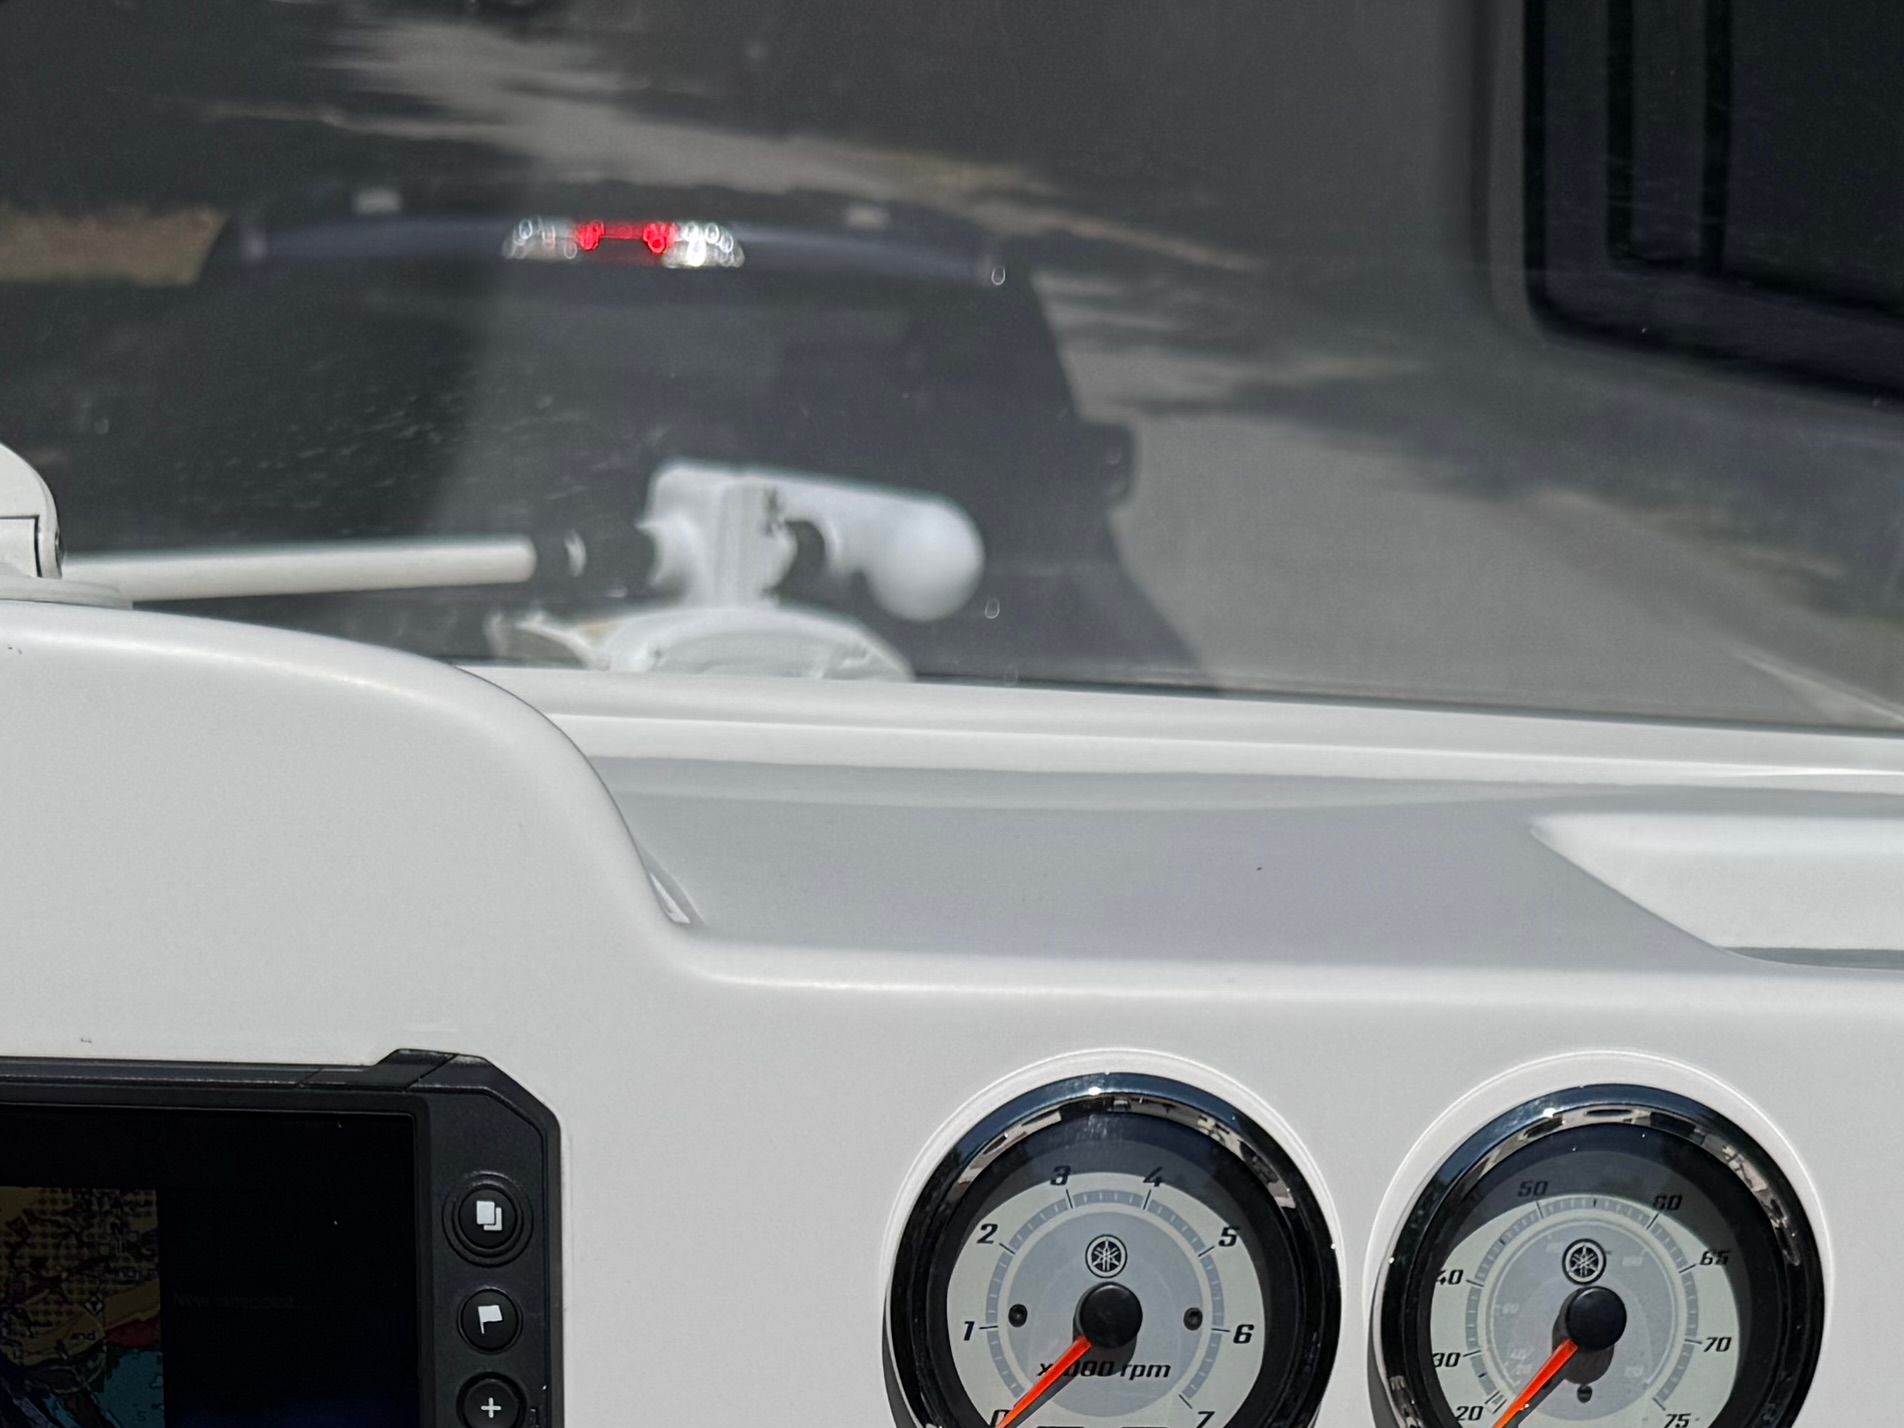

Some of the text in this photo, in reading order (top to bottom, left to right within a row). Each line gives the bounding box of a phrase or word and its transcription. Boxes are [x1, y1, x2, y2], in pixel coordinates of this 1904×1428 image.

[1050, 1164, 1072, 1187] 3
[1143, 1165, 1166, 1189] 4
[1517, 1179, 1550, 1198] 50
[976, 1223, 1000, 1246] 2
[1217, 1226, 1241, 1248] 5
[962, 1320, 977, 1342] 1
[1232, 1323, 1256, 1346] 6
[1702, 1336, 1735, 1354] 70
[1037, 1360, 1173, 1381] x000 rpm
[1455, 1405, 1485, 1424] 20
